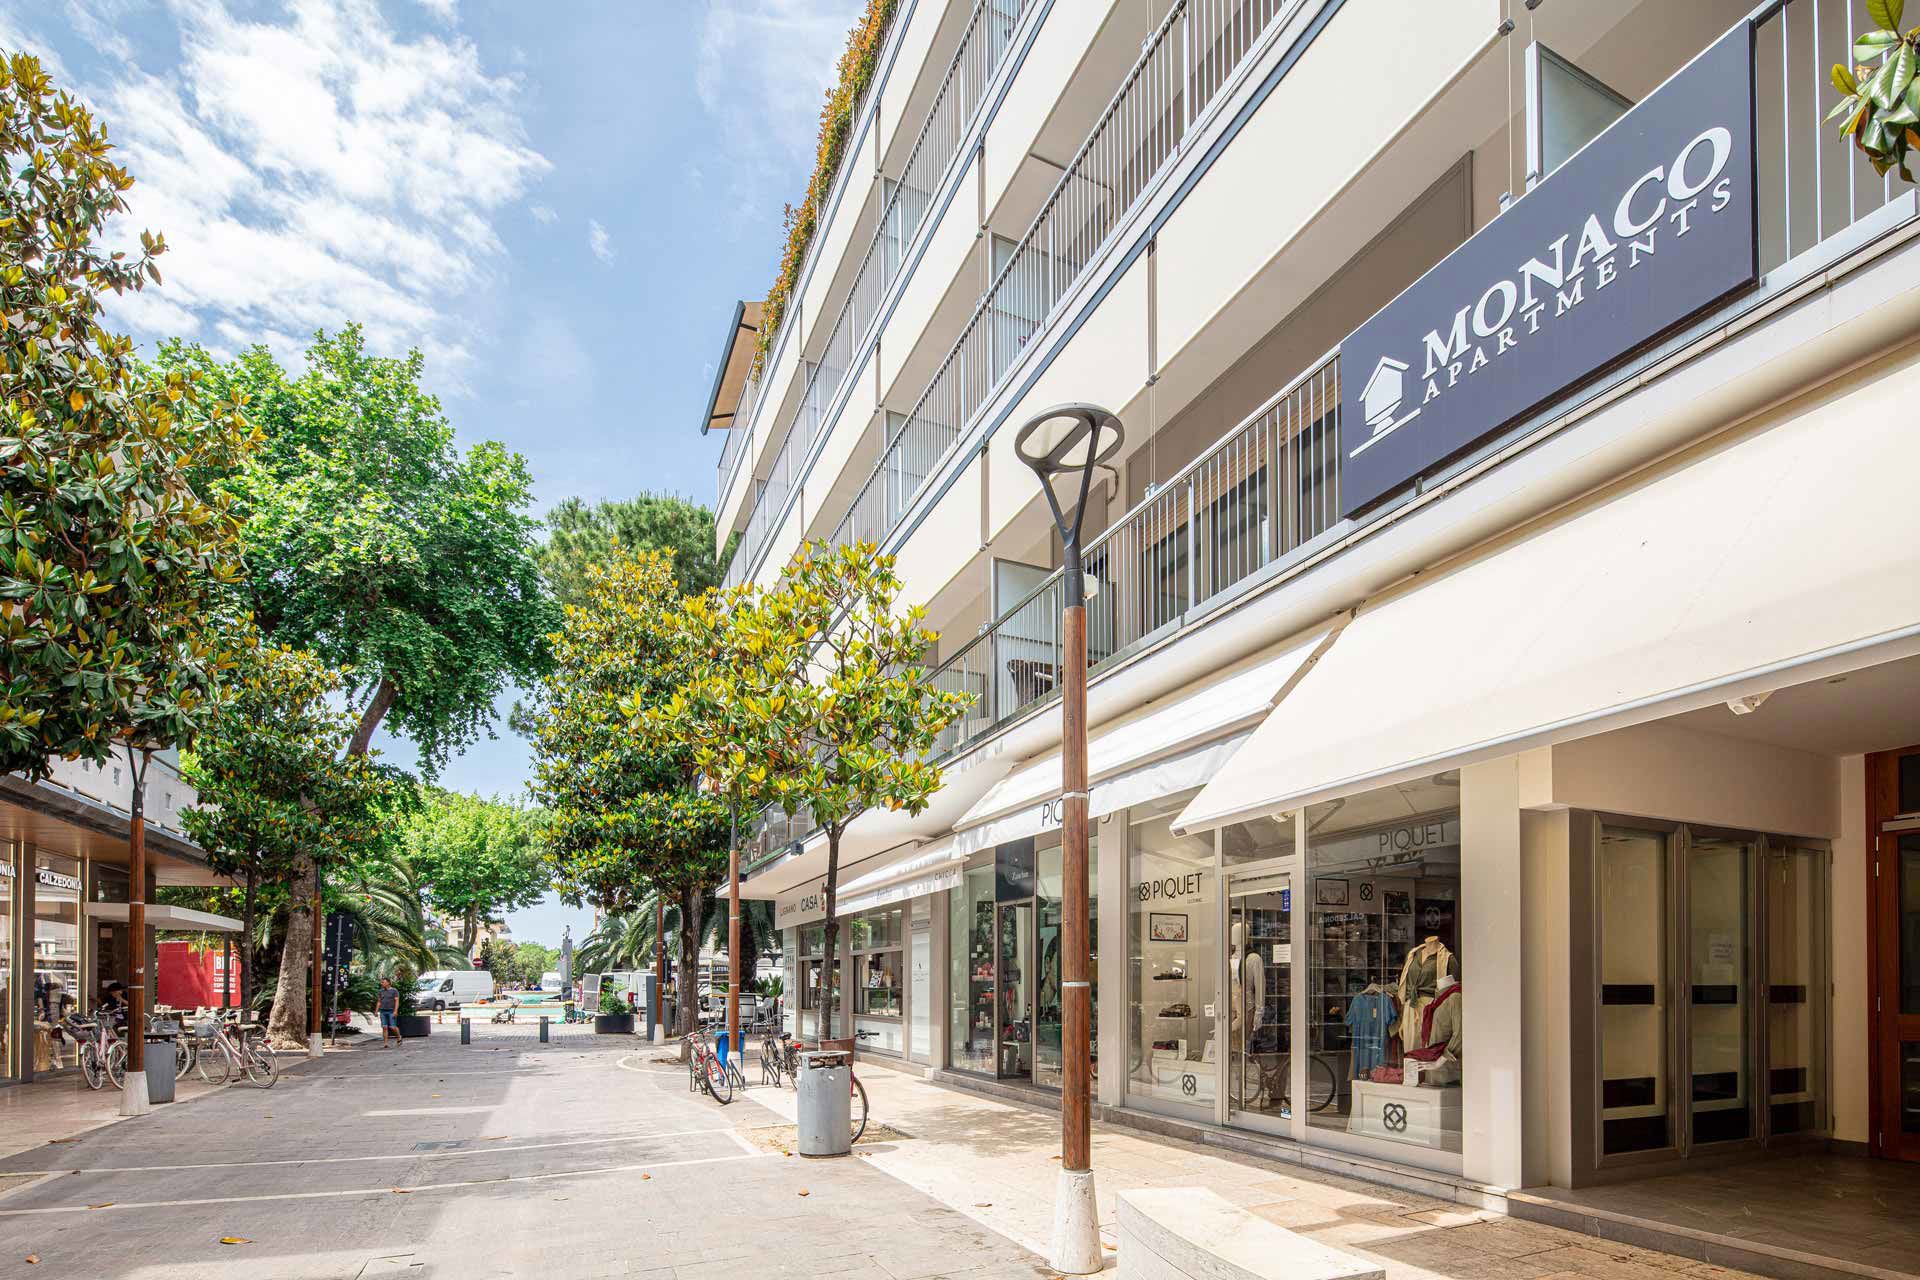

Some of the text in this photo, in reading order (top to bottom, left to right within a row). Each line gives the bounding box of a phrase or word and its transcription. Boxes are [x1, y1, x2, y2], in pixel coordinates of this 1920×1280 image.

[1422, 126, 1732, 380] MONACO
[1423, 177, 1731, 404] APARTMENTS
[1041, 787, 1095, 827] PIQT
[1379, 821, 1447, 852] PIQUET
[0, 863, 16, 878] NIA
[39, 872, 83, 891] CALZEDONIA
[1152, 872, 1203, 900] PIQUET
[800, 893, 818, 913] CASA
